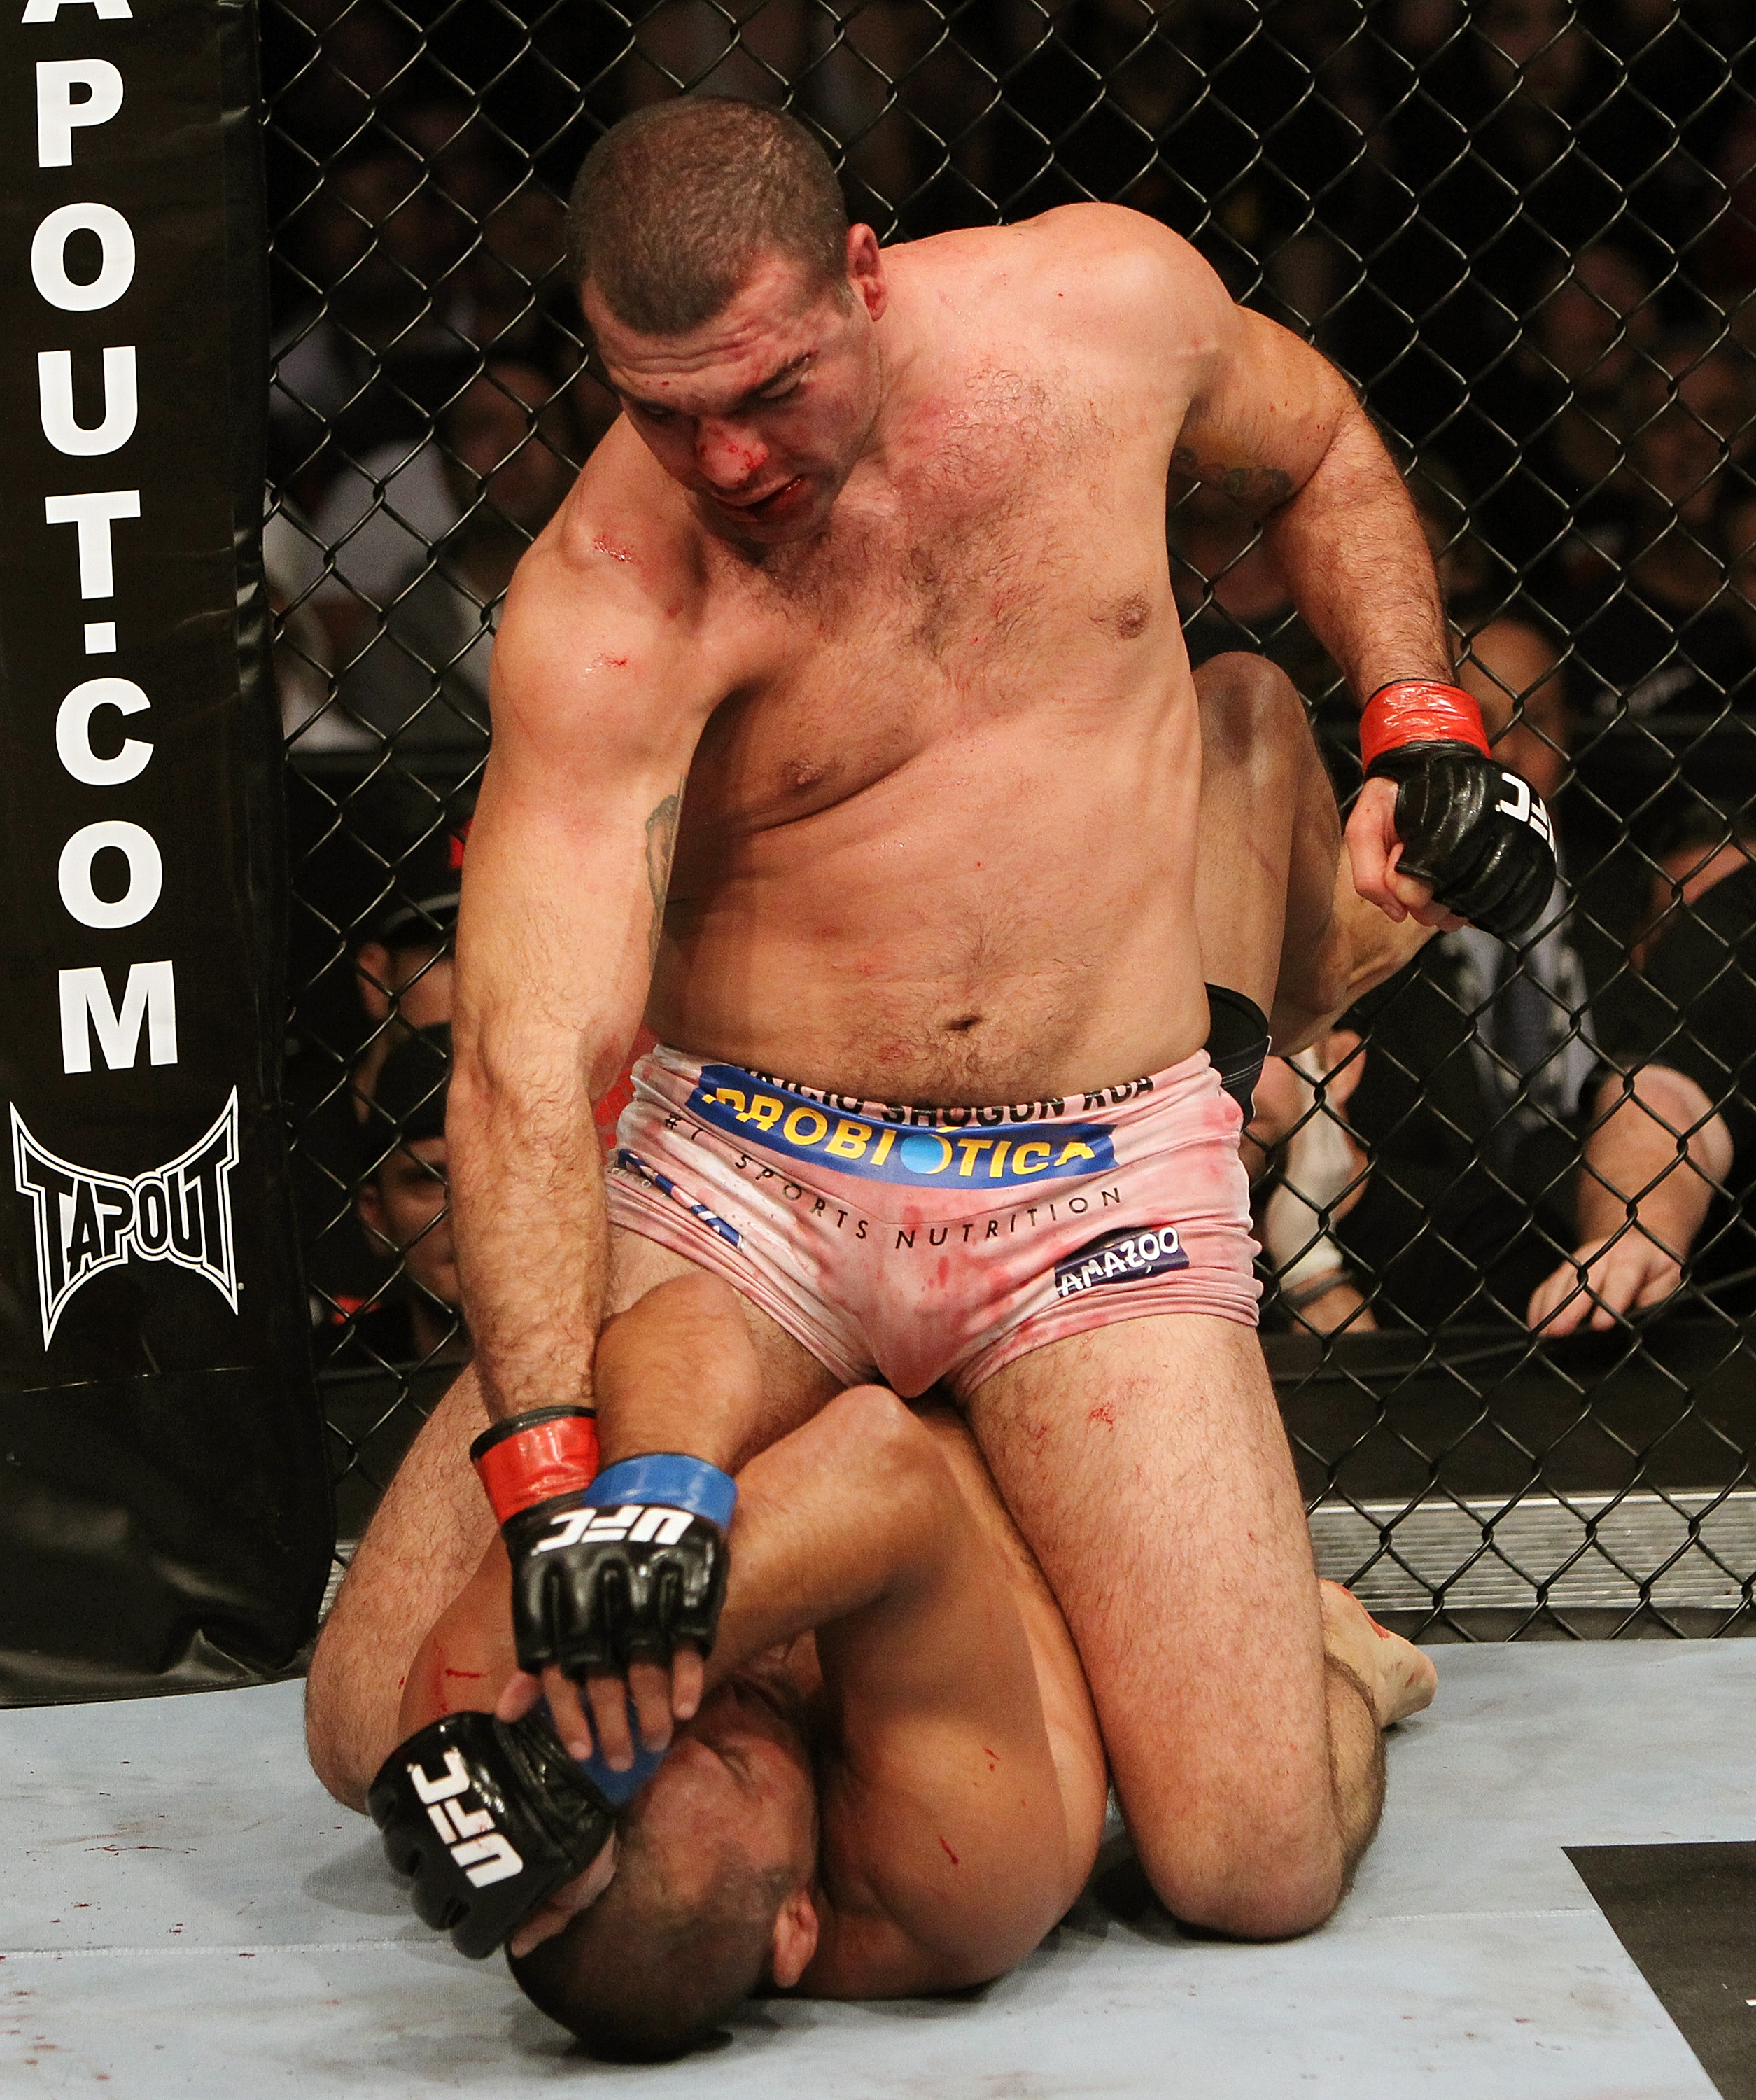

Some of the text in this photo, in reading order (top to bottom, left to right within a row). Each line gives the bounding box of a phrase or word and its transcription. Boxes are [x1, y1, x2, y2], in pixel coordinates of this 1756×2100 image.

[22, 0, 178, 1074] POUT.COM
[10, 1085, 239, 1351] TAPOUT
[734, 1154, 869, 1239] SPORTS
[895, 1187, 1121, 1250] NUTRITION
[1057, 1226, 1179, 1296] AMAZOO
[534, 1504, 695, 1554] UFC
[410, 1749, 524, 1889] UFC
